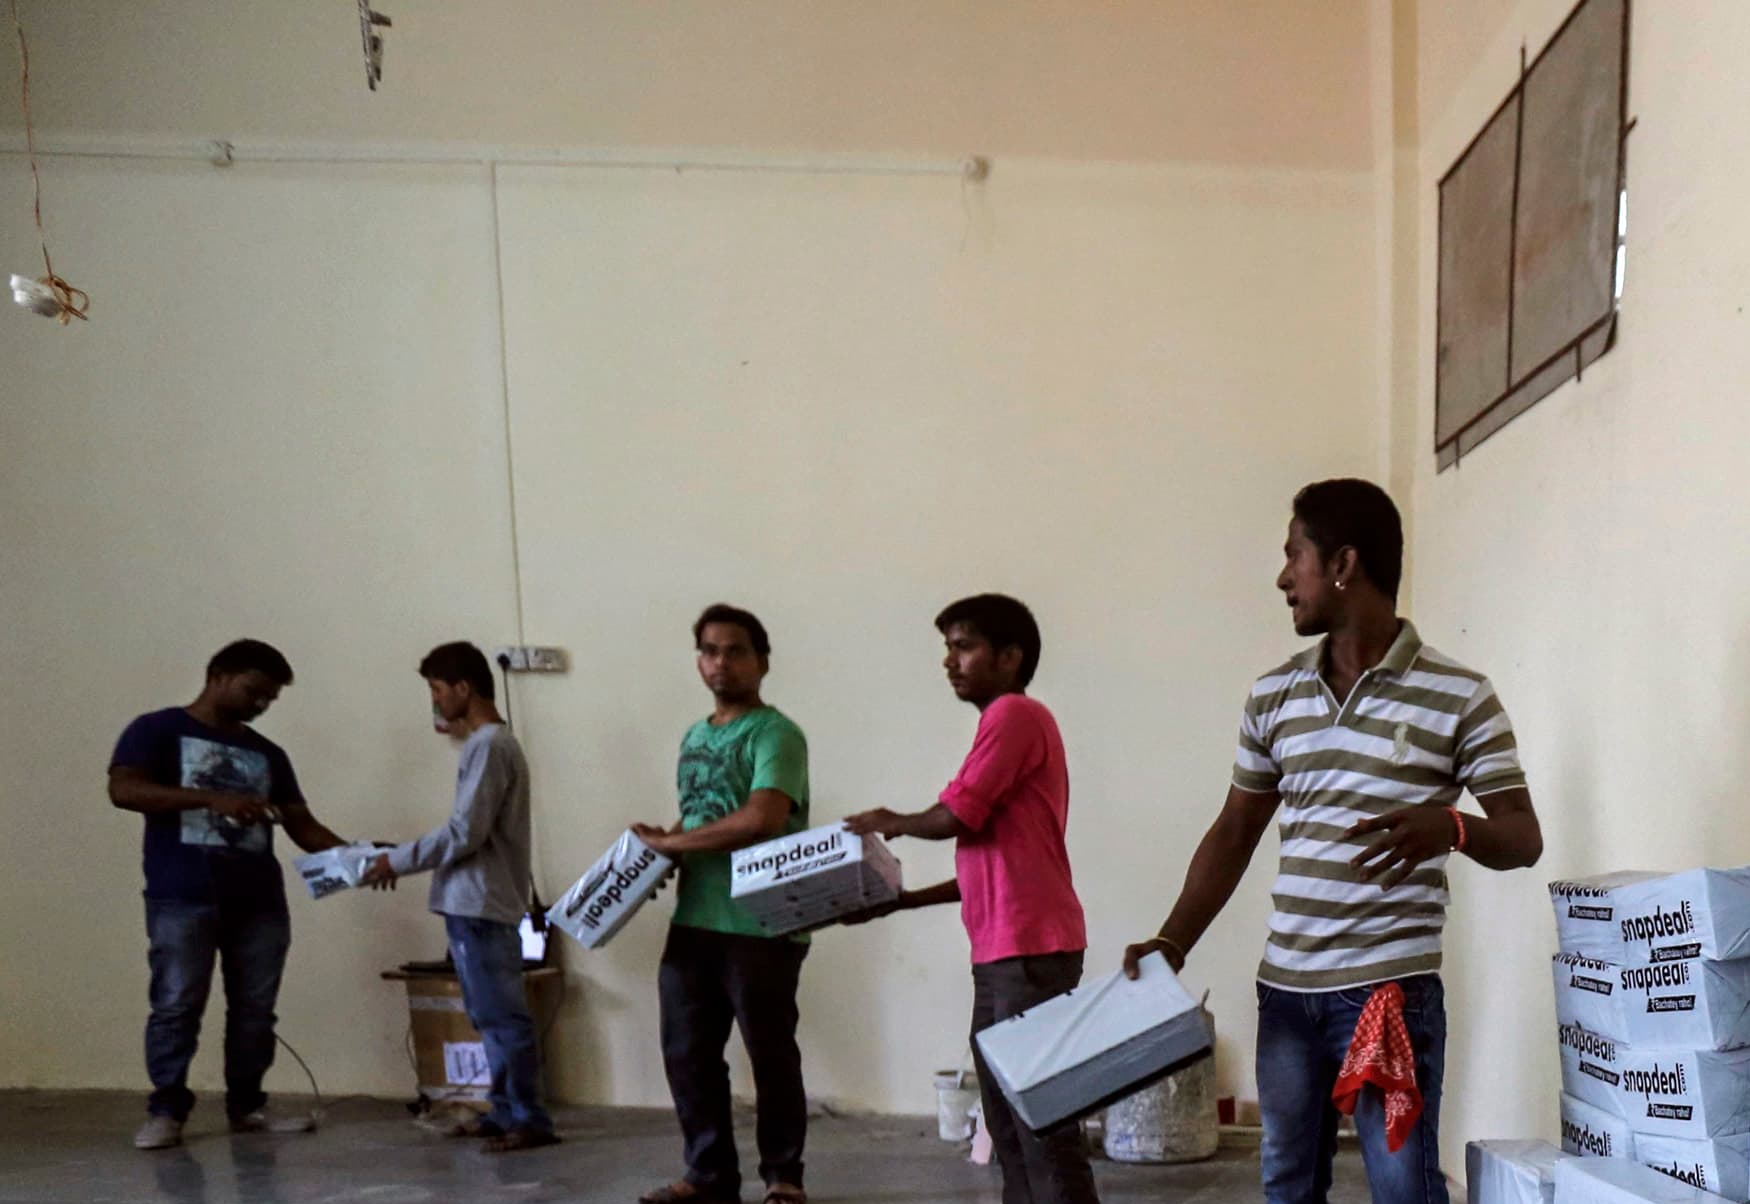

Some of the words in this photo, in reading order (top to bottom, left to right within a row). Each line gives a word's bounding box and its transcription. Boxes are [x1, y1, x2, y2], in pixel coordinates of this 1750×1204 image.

[737, 834, 838, 876] snapdeal
[1621, 900, 1688, 948] snapdeal
[1624, 1063, 1682, 1100] snapdeal
